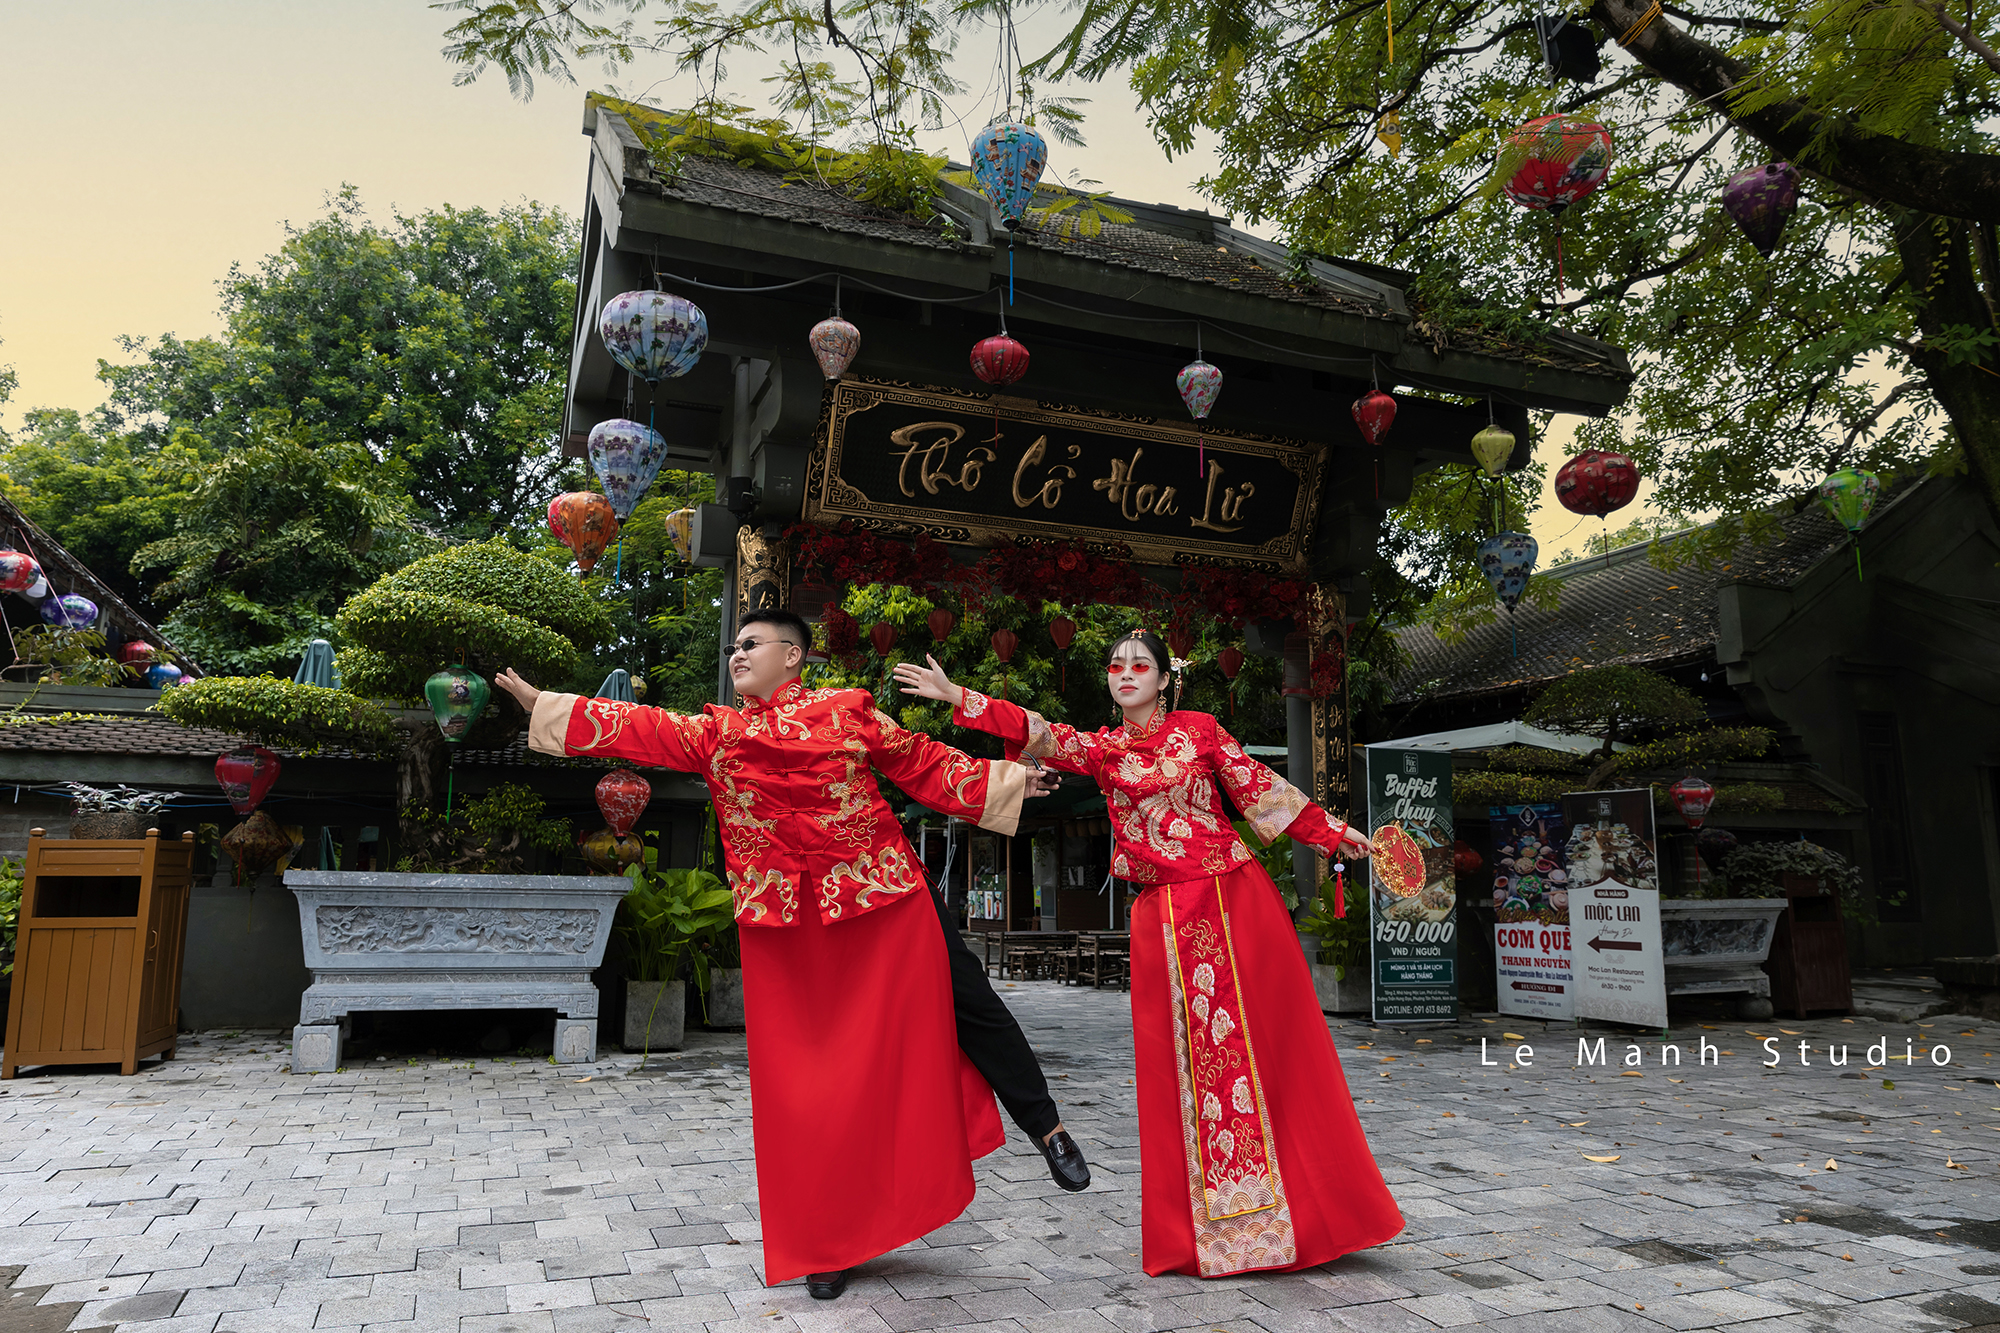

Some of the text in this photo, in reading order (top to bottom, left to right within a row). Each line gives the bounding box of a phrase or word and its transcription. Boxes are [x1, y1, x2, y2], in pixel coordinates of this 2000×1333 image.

[888, 421, 1255, 533] Phố Cổ Hoa Lư
[1384, 774, 1438, 798] Buffet
[1394, 798, 1436, 828] Chay
[1584, 902, 1640, 923] MỘC LAN
[1376, 920, 1454, 943] 150.000
[1498, 926, 1572, 955] CƠM QUÊ
[1391, 946, 1441, 956] VNĐ / NGƯỜI
[1501, 956, 1531, 967] THANH
[1612, 968, 1644, 976] Restaurant
[1384, 1005, 1452, 1014] HOTLINE: 091 613 8692
